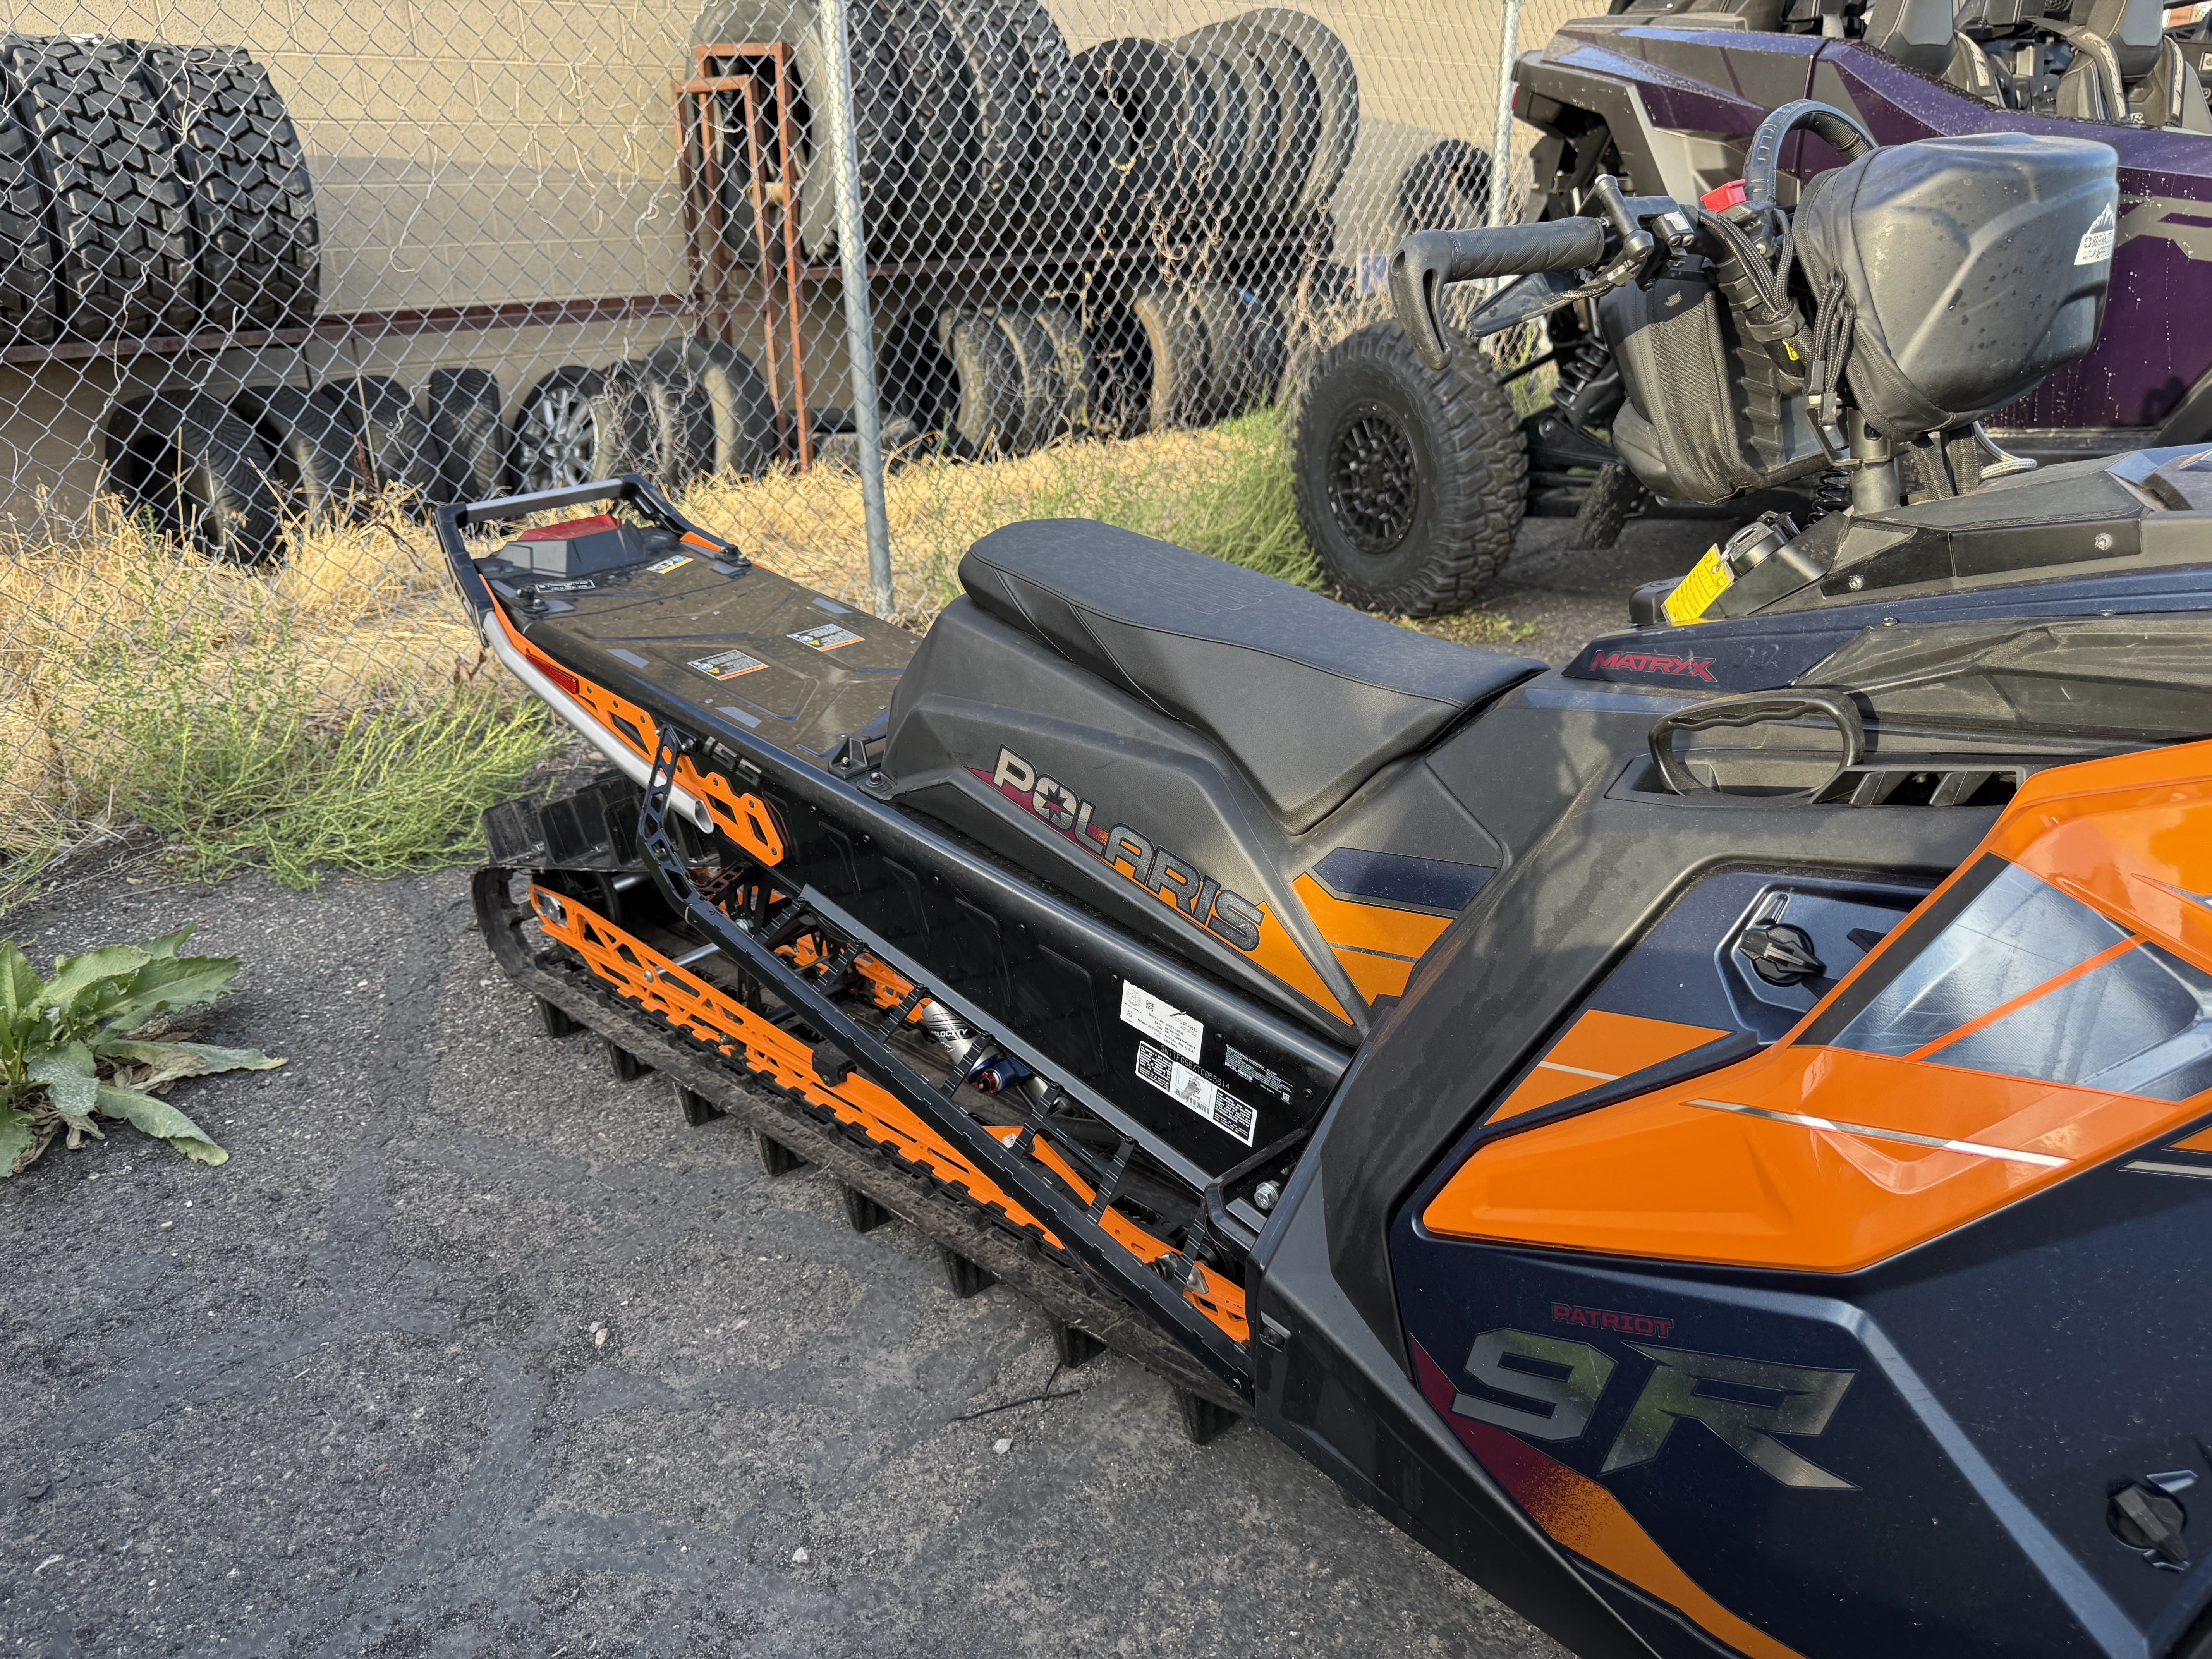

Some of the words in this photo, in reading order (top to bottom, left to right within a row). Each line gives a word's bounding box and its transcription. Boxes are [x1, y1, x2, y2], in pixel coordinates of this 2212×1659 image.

[1590, 650, 1716, 682] MATRYX
[993, 744, 1264, 951] POLARIS
[1161, 1044, 1230, 1091] SN1TFG9BXTC055614
[1224, 1061, 1253, 1081] POLARIS
[1551, 1302, 1674, 1338] PATRIOT
[1449, 1328, 1862, 1491] 9R
